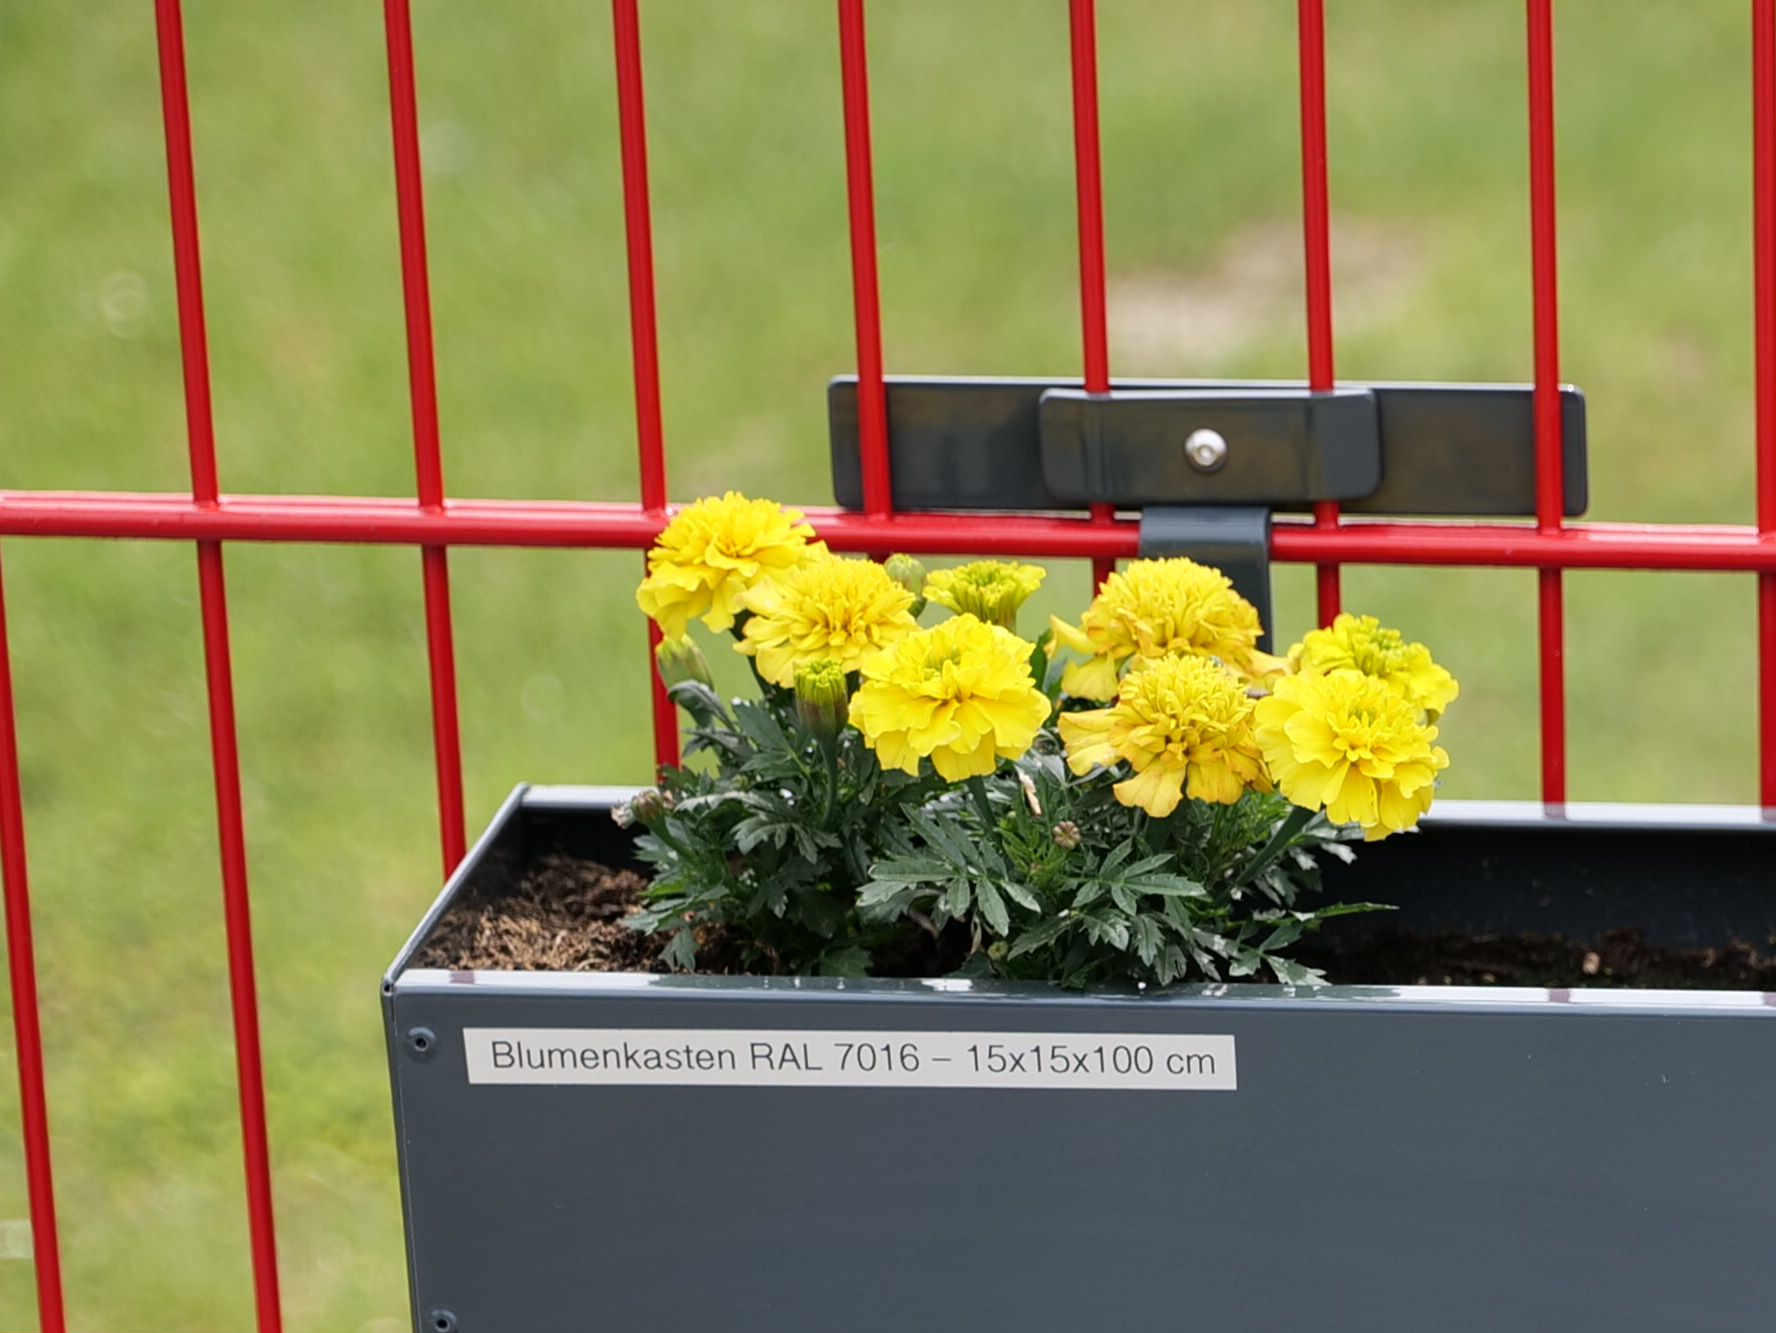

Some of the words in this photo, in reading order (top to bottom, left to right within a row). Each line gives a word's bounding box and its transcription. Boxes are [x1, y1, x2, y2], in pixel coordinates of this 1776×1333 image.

[491, 1040, 736, 1070] Blumenkasten
[750, 1042, 823, 1071] RAL
[834, 1043, 920, 1072] 7016
[968, 1044, 1154, 1074] 15x15x100
[1166, 1053, 1215, 1075] cm
